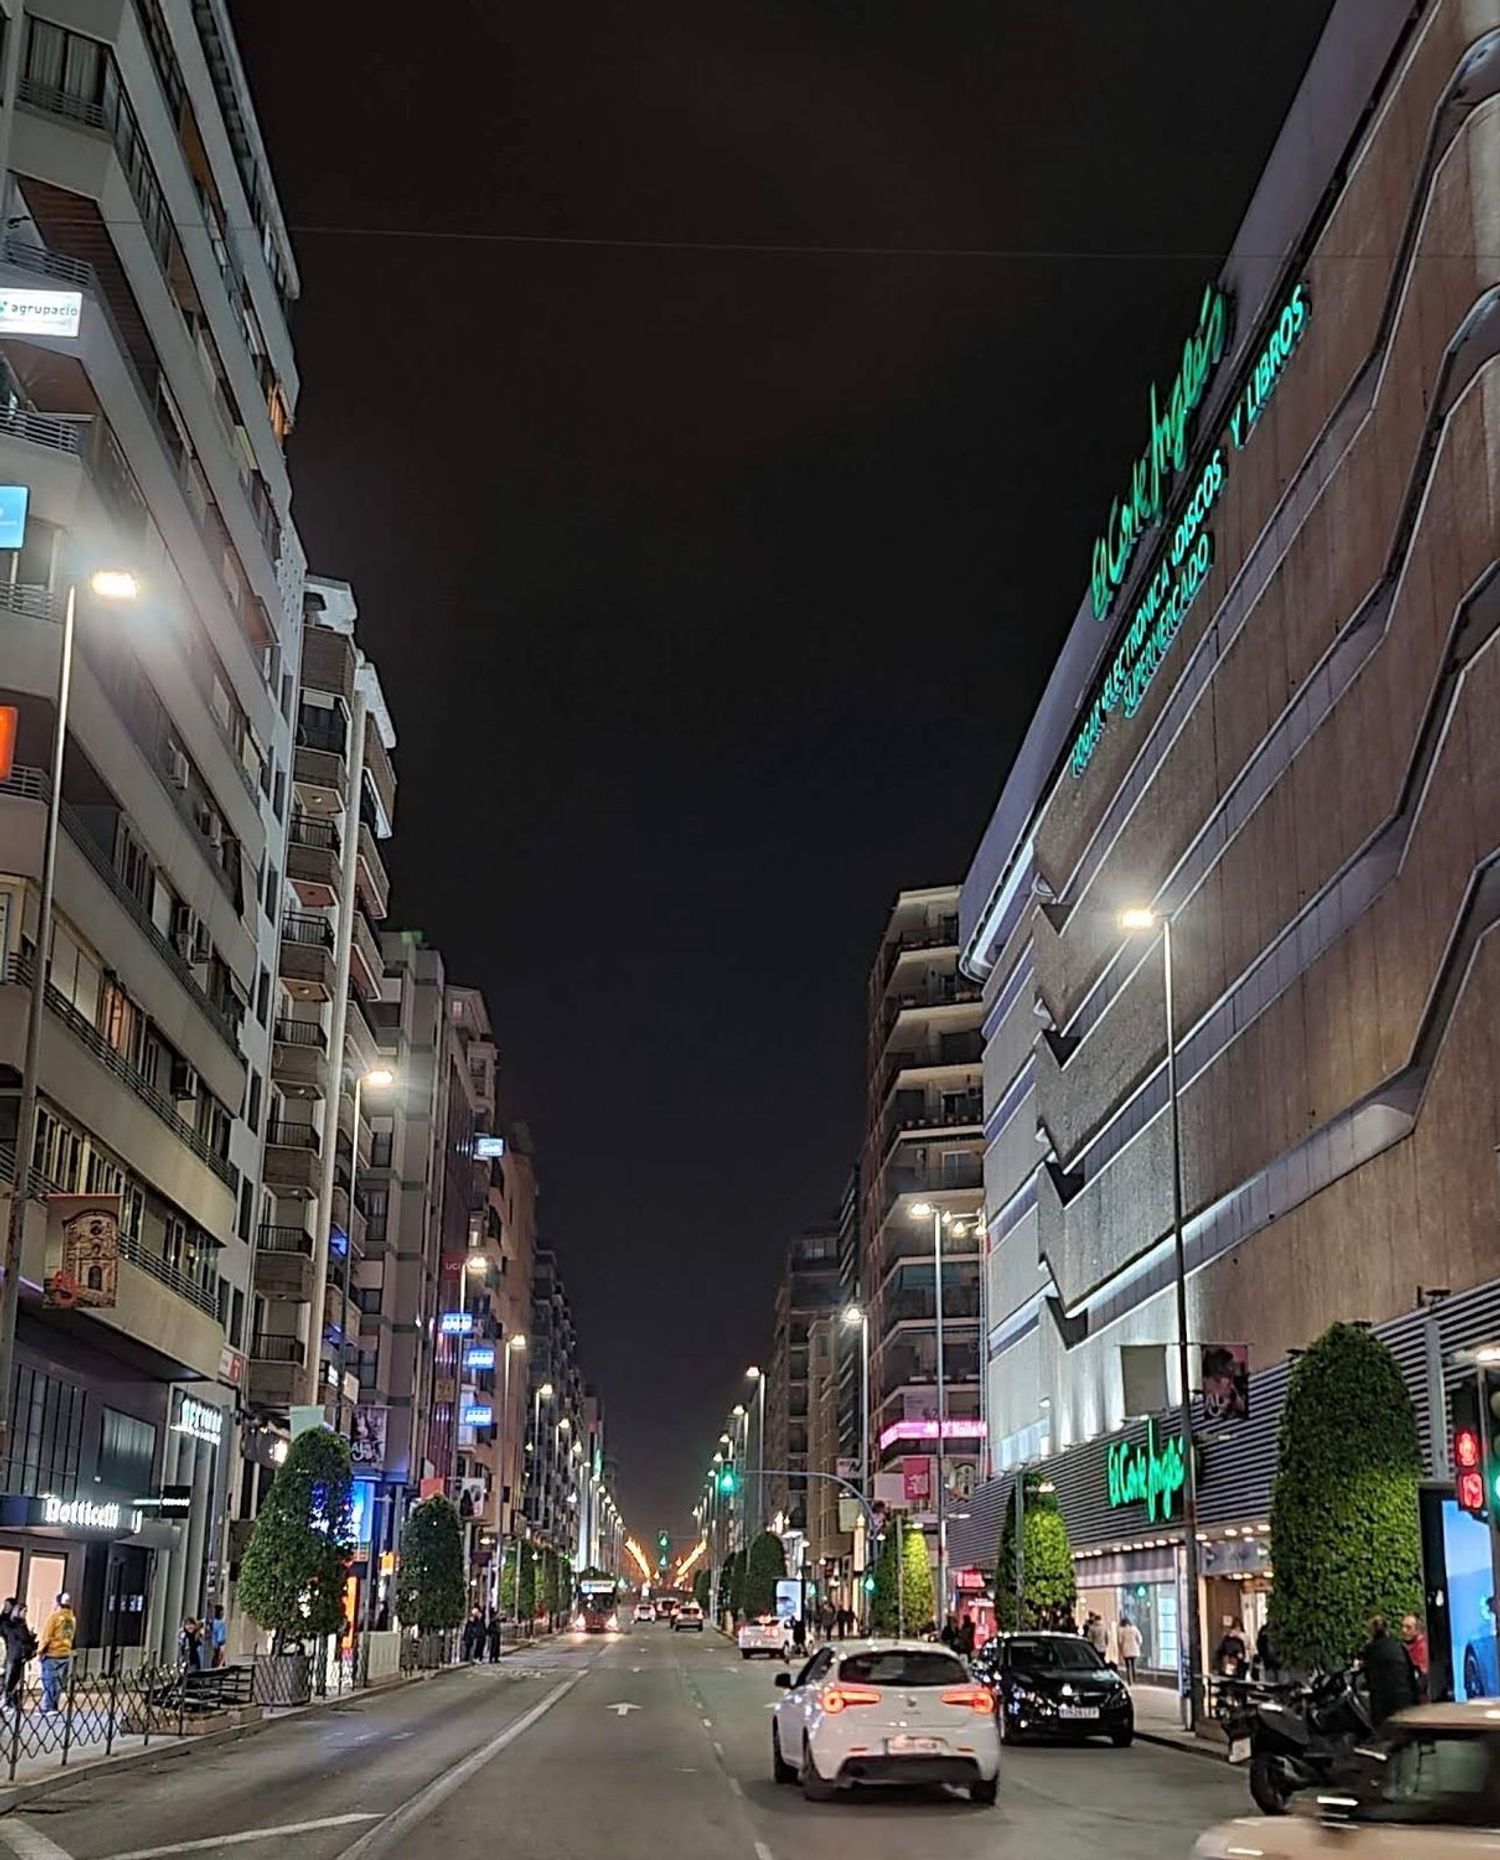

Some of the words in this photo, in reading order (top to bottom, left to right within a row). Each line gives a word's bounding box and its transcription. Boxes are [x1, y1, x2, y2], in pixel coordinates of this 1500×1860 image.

[1230, 402, 1241, 448] Y
[1247, 284, 1304, 422] LIBROS
[1092, 536, 1110, 619] El
[1109, 460, 1150, 584] Corte
